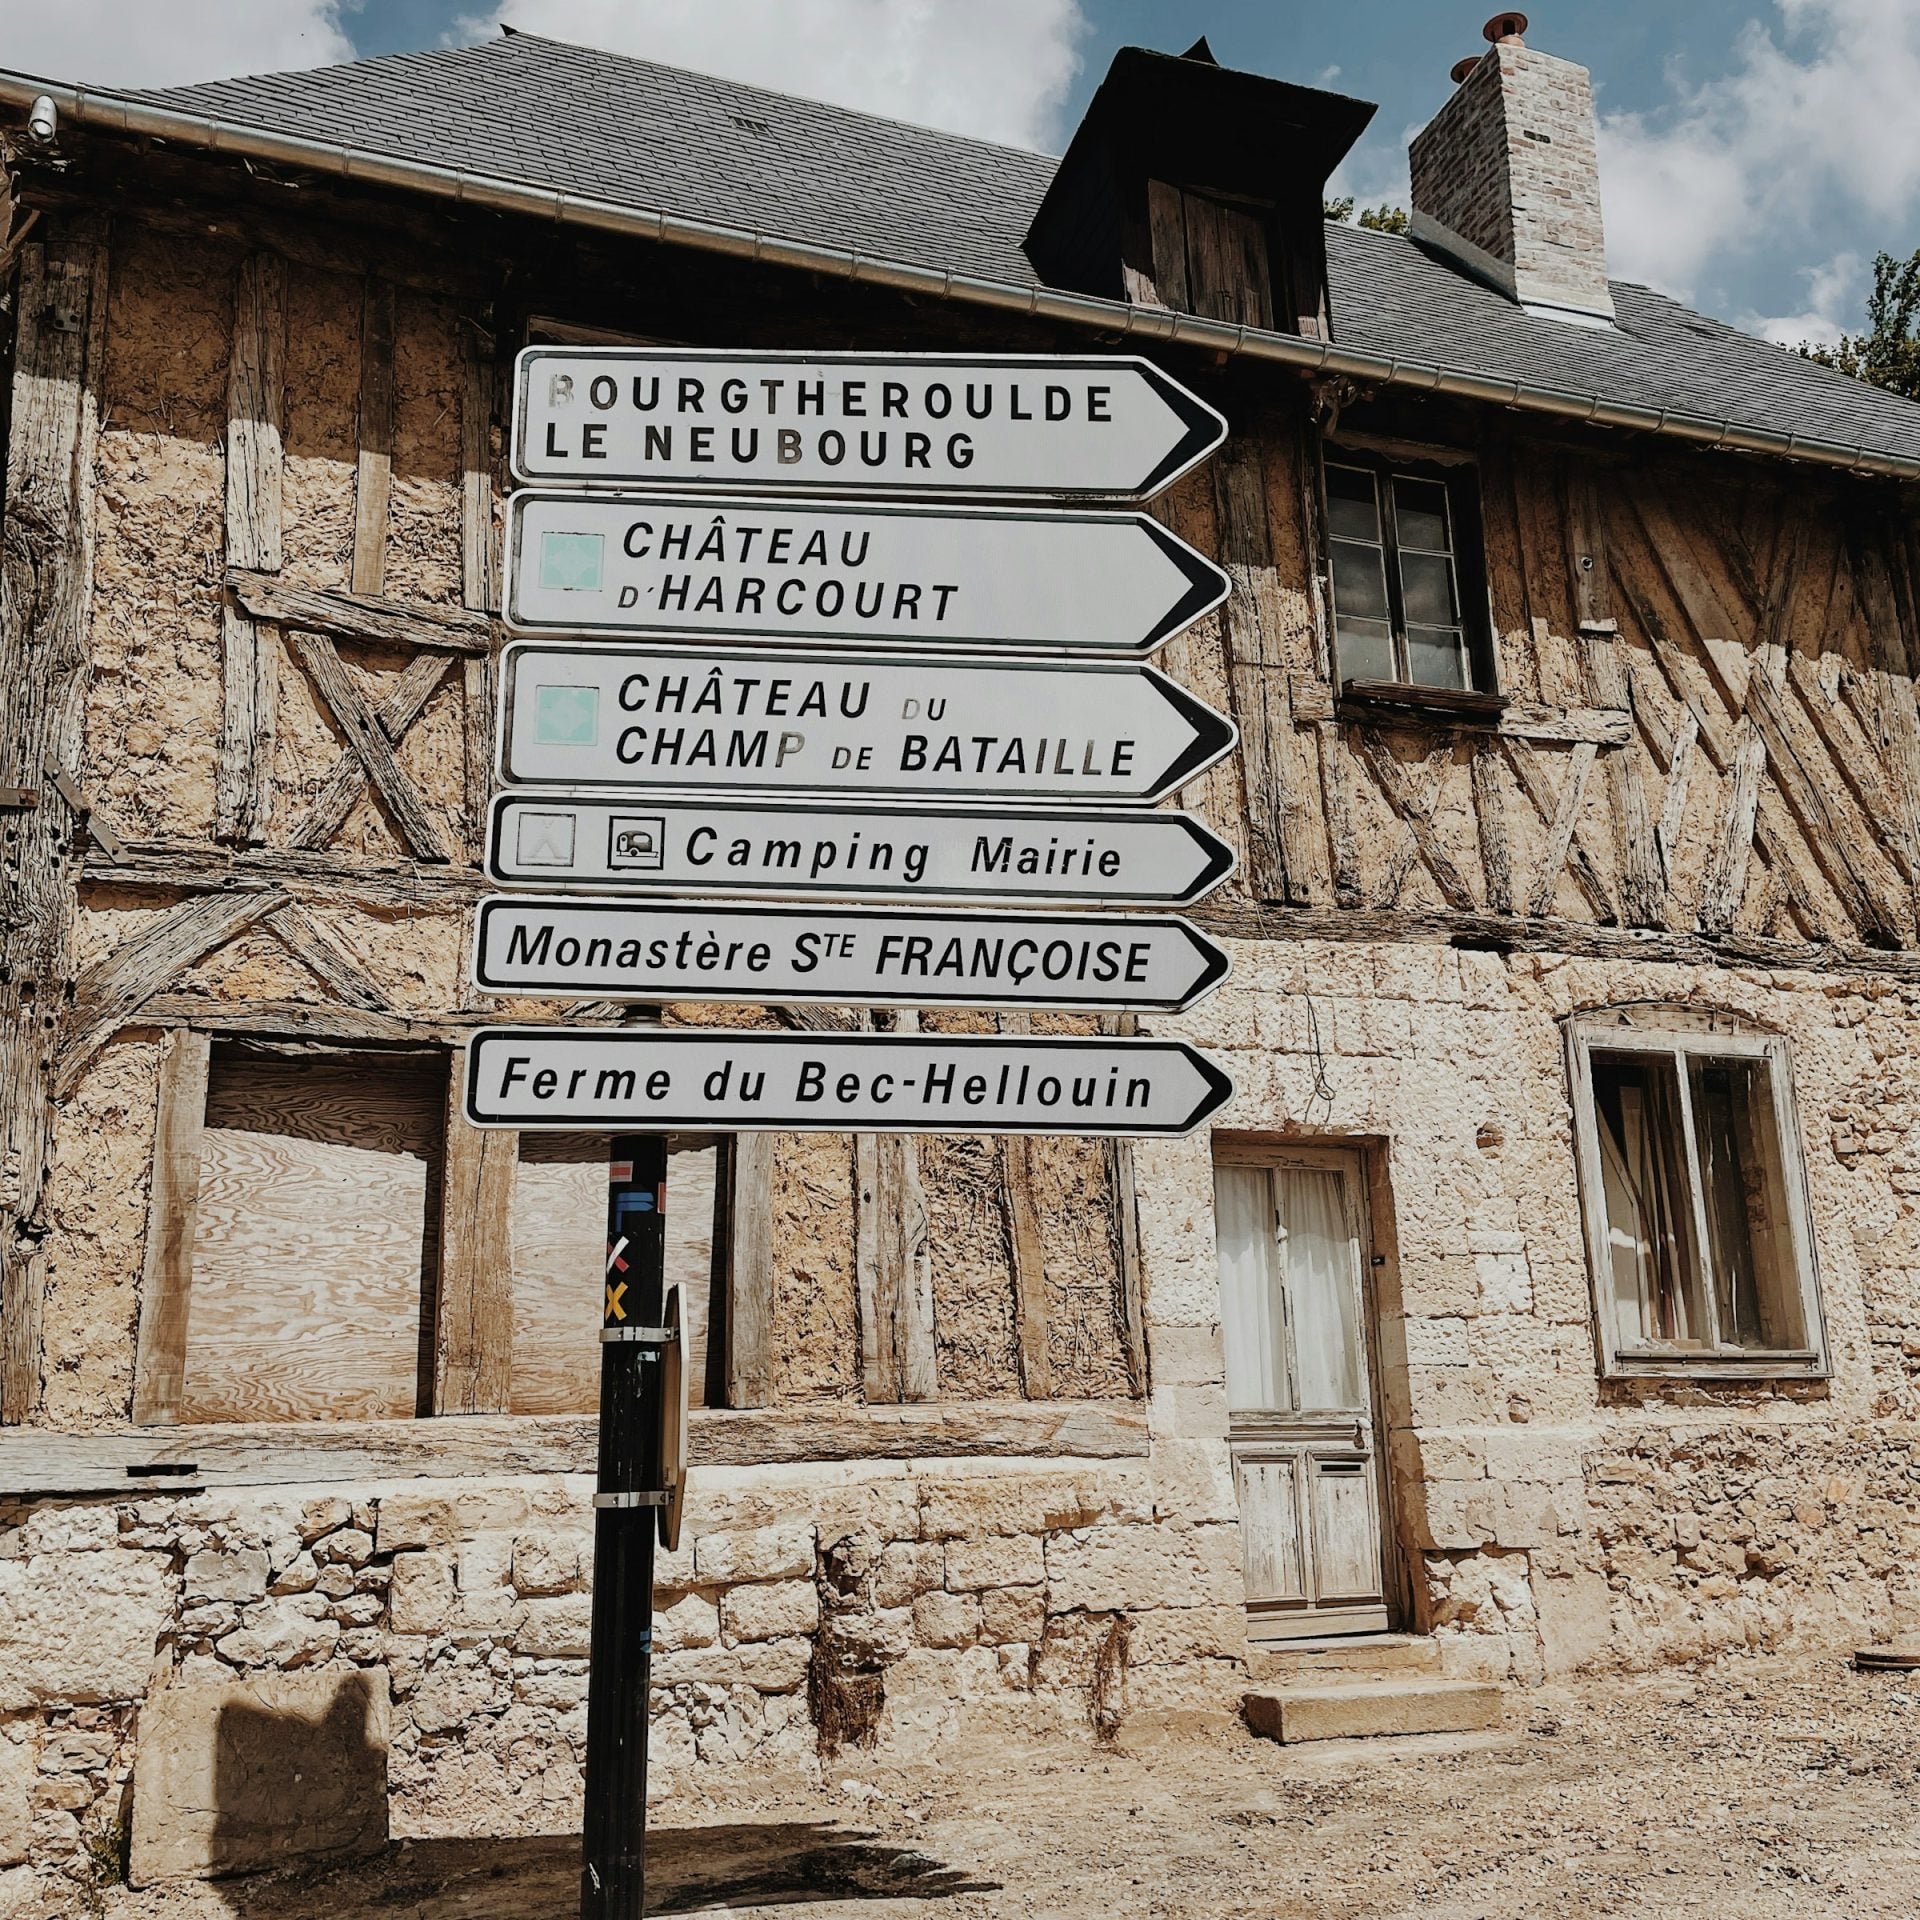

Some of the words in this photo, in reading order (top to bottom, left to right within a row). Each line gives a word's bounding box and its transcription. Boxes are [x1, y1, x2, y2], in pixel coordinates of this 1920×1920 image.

[546, 422, 607, 459] LE
[644, 425, 974, 469] NEUBOURG
[623, 515, 870, 567] CHÂTEAU
[618, 666, 870, 718] CHÂTEAU
[901, 698, 946, 721] DU
[616, 726, 805, 768] CHAMP
[831, 746, 873, 770] DE
[900, 735, 1135, 776] BATAILLE
[687, 826, 929, 883] Camping
[971, 836, 1121, 877] Mairie
[506, 925, 771, 973] Monastère
[875, 935, 1152, 986] FRANÇOISE
[499, 1056, 671, 1100] Ferme
[703, 1060, 765, 1101] du
[795, 1061, 1151, 1107] Bec-Hellouin
